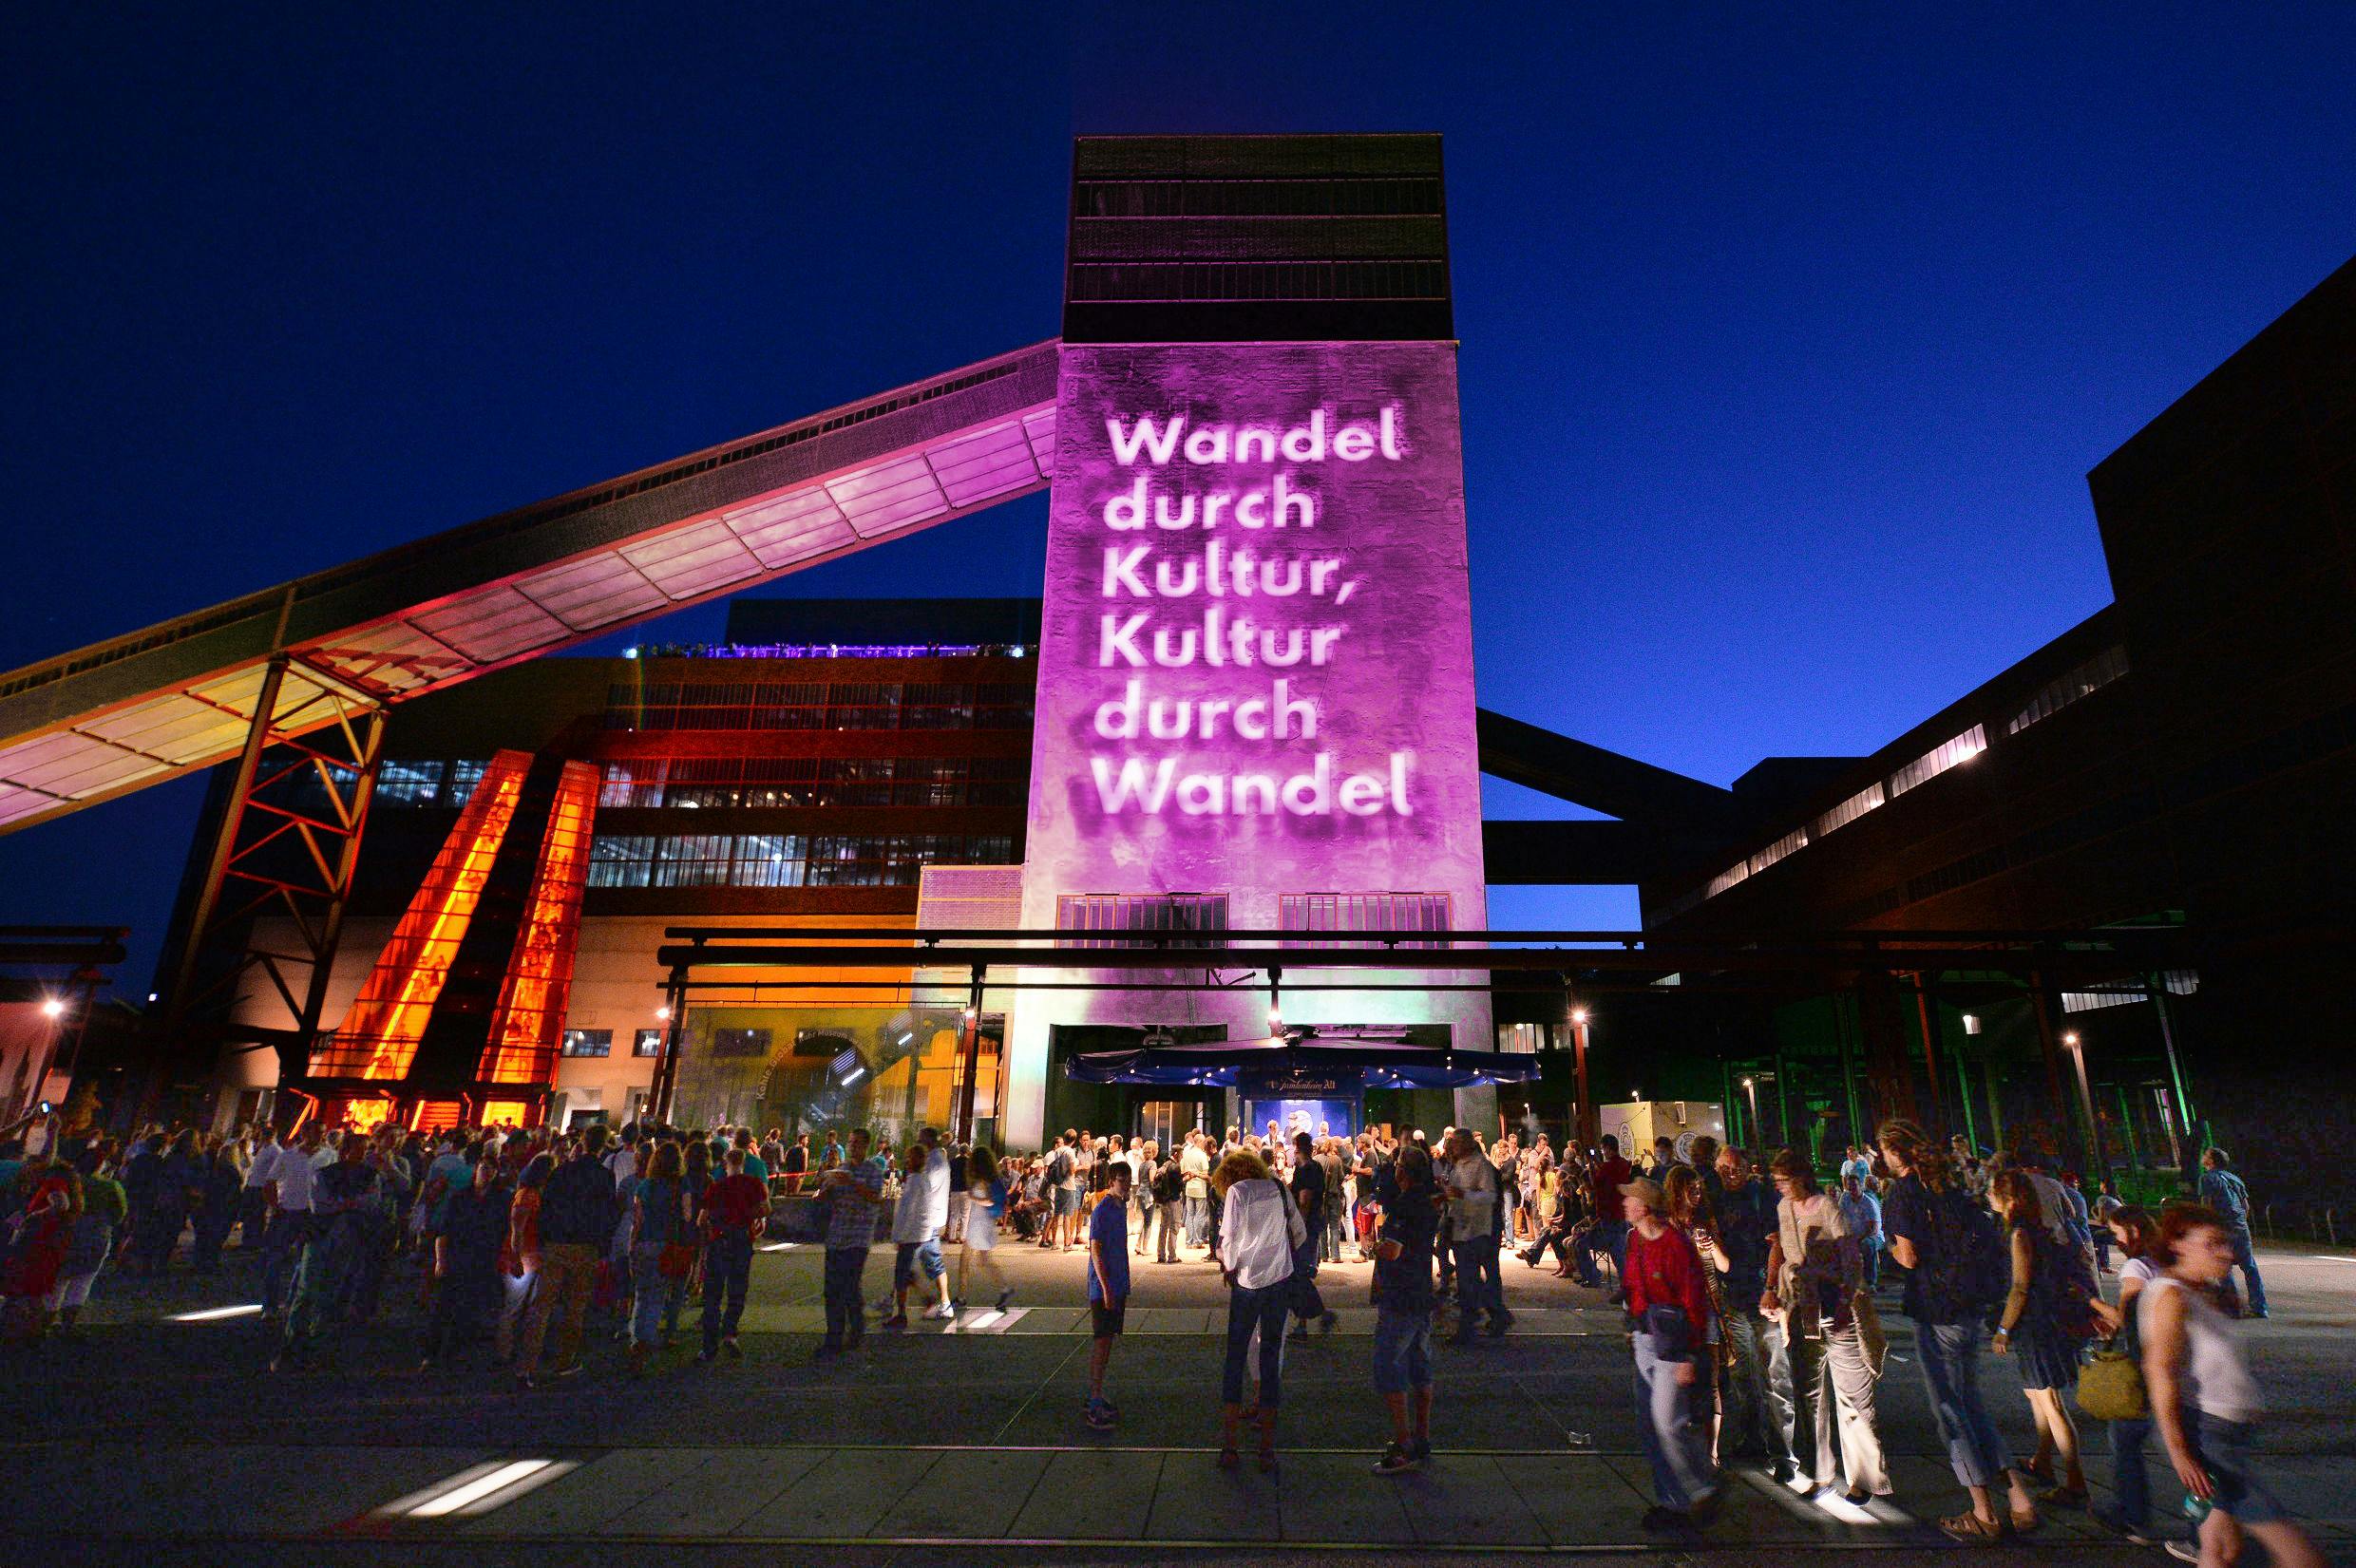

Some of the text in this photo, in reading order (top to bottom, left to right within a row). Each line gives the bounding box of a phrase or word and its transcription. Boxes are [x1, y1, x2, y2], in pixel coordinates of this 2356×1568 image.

[1105, 406, 1401, 465] Wandel
[1103, 475, 1315, 530] durch
[1102, 539, 1357, 605] Kultur,
[1098, 606, 1342, 667] Kultur
[1093, 679, 1317, 740] durch
[1090, 752, 1414, 816] Wandel
